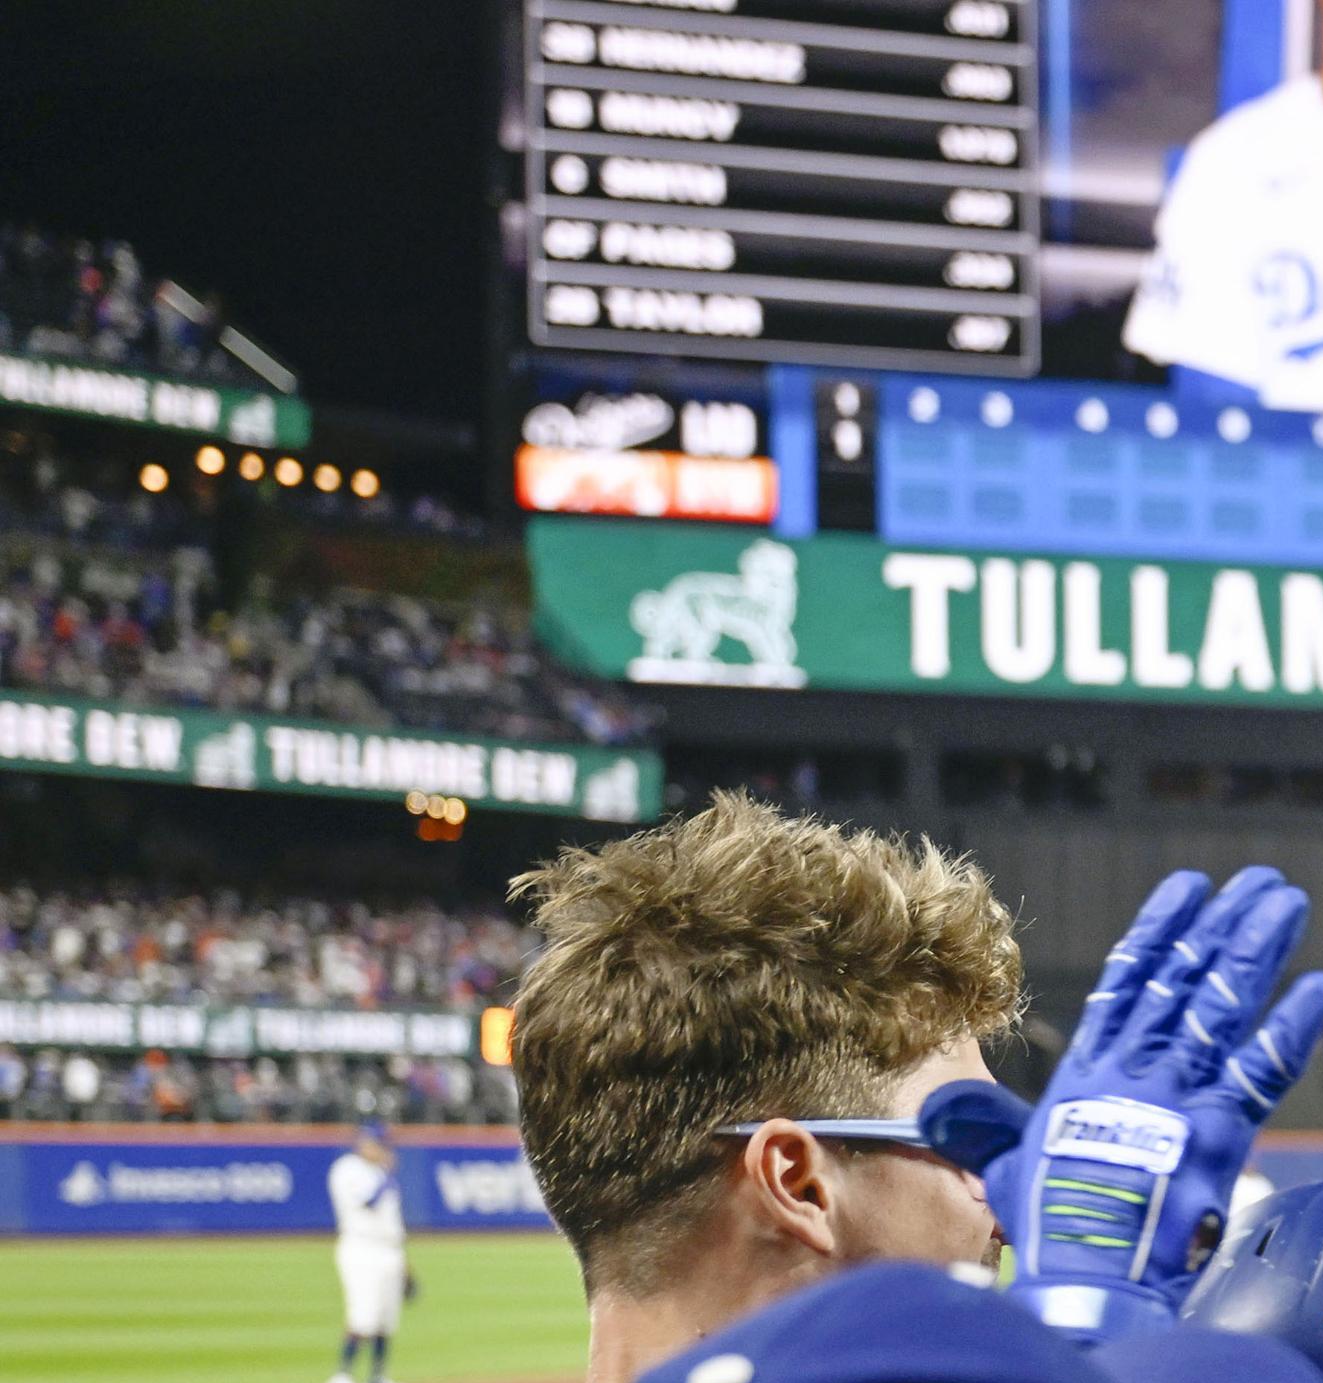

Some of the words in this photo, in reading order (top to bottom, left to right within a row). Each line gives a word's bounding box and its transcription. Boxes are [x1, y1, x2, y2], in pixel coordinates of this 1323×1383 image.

[86, 710, 183, 772] DEW
[266, 726, 488, 800] TULLAMORE
[492, 747, 577, 806] DEW
